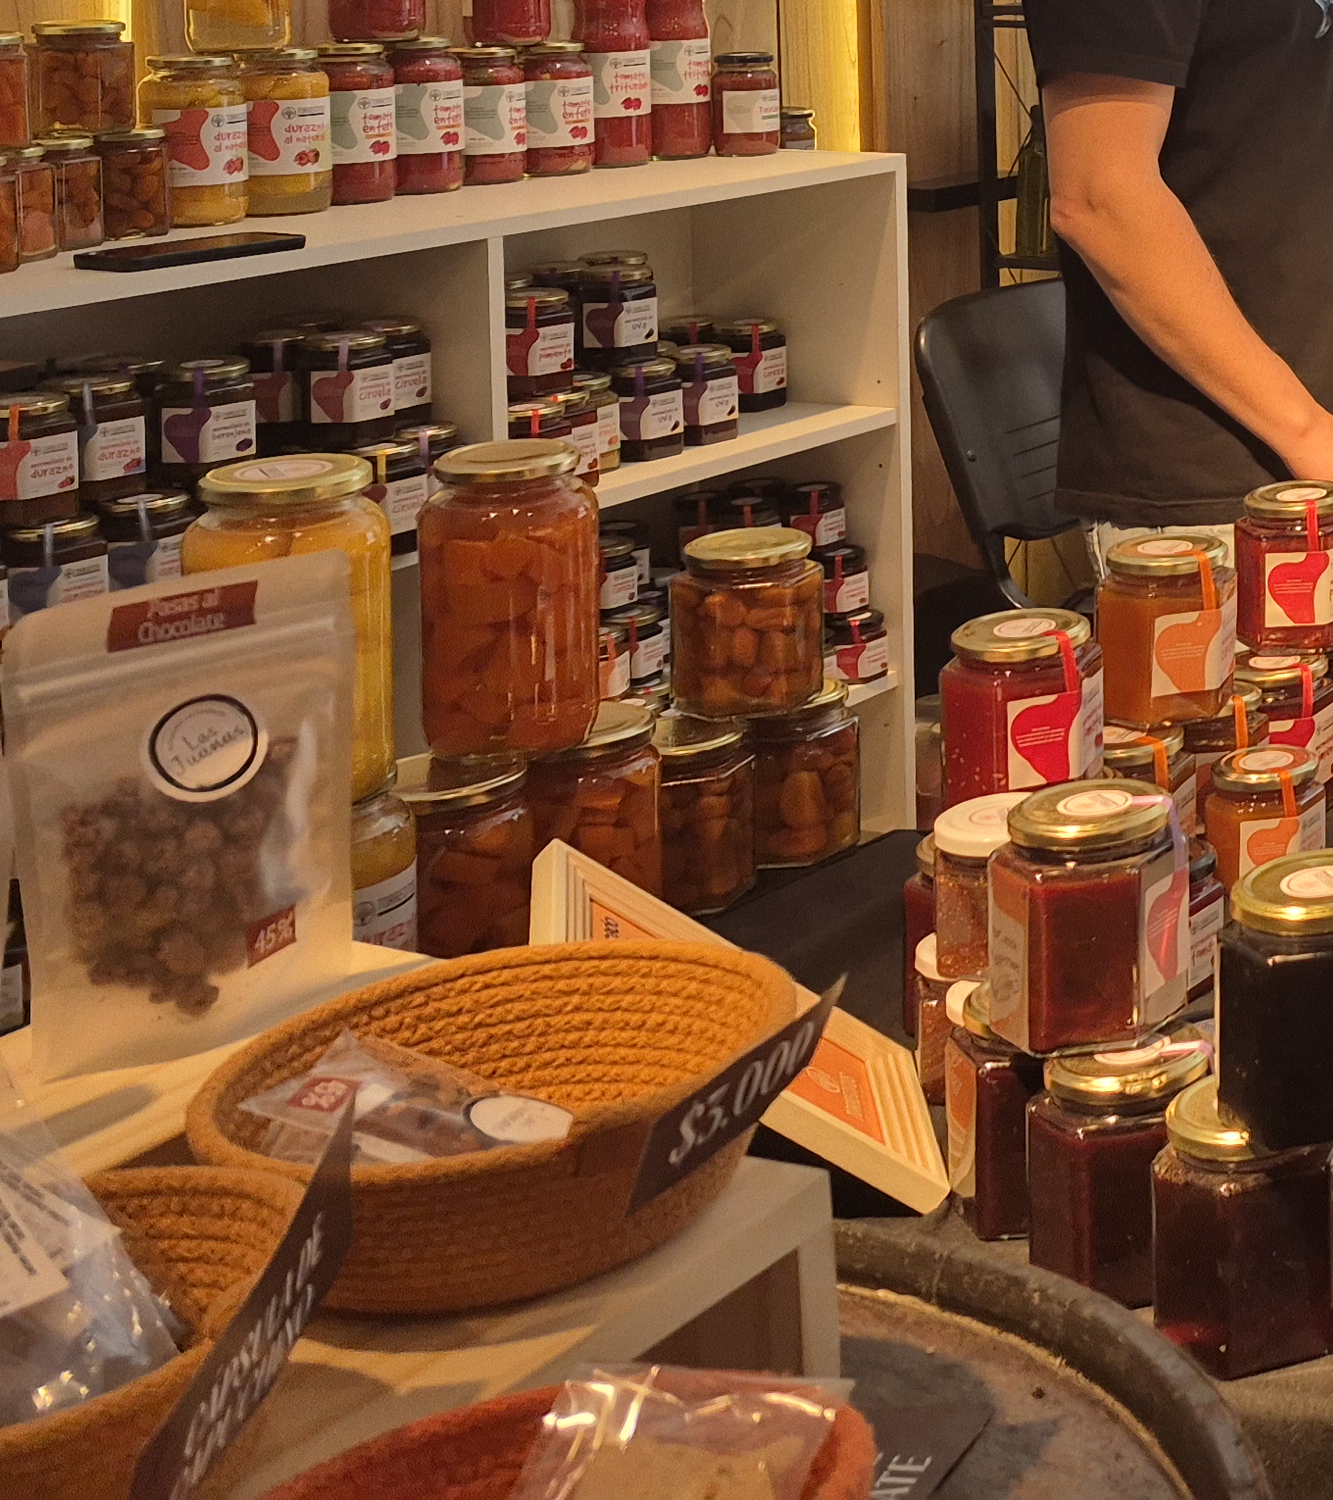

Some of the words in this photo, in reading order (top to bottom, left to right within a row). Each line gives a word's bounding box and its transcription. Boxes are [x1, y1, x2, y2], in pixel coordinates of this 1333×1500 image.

[97, 446, 141, 462] durazno
[30, 463, 74, 479] durazno
[138, 612, 226, 643] Chocolate
